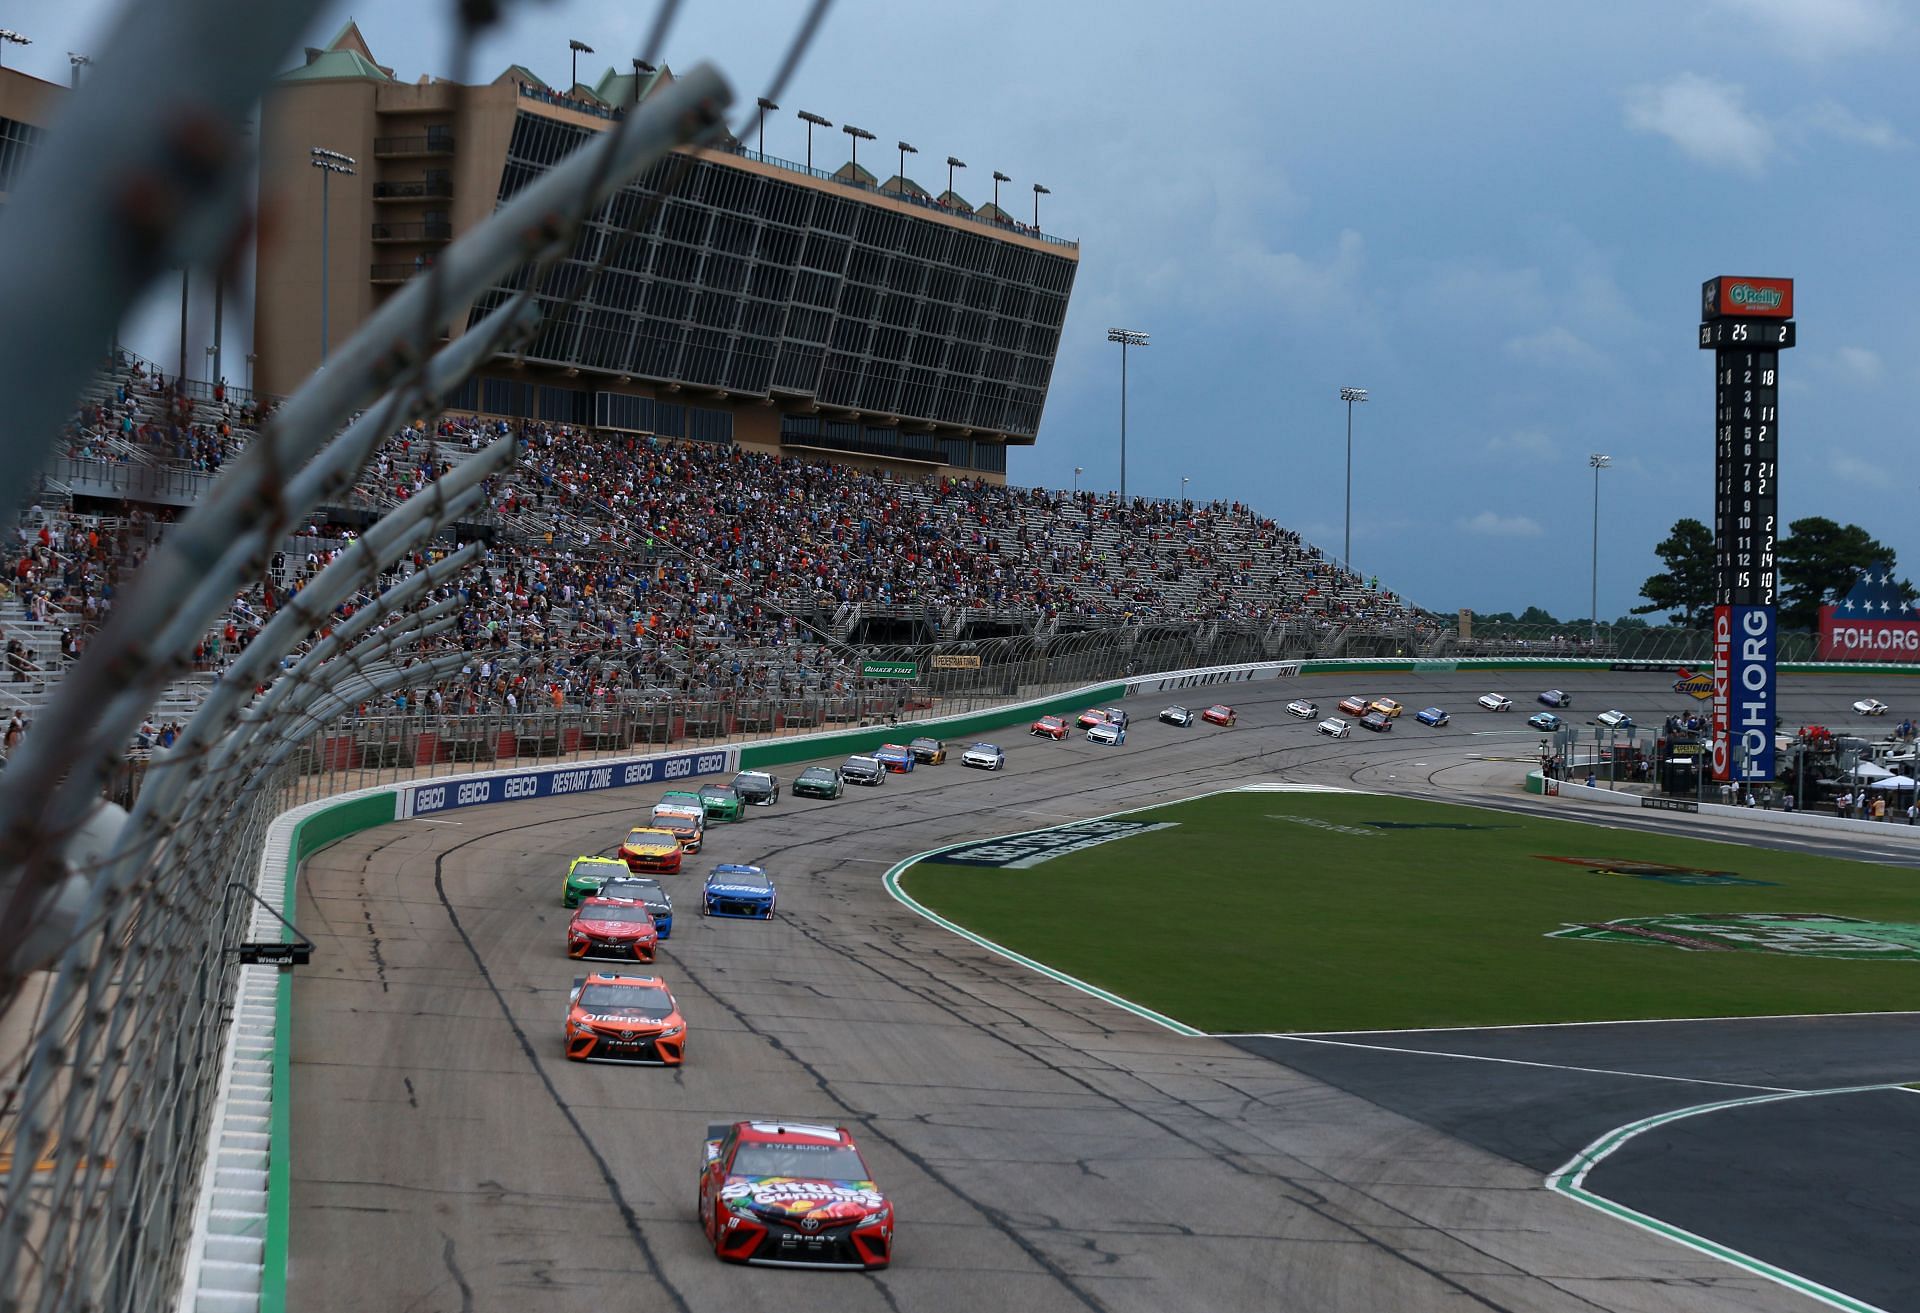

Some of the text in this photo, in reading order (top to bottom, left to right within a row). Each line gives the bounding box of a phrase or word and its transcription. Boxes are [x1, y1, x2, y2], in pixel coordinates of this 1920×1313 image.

[1730, 283, 1784, 308] O'Reilly
[1732, 324, 1787, 342] 25 2
[1746, 354, 1752, 366] 1
[1743, 370, 1774, 386] 2 18
[1744, 391, 1751, 403] 3
[1743, 406, 1774, 421] 4 11
[1744, 426, 1767, 442] 5 2
[1744, 444, 1751, 456] 6
[1743, 464, 1751, 476] 7
[1759, 462, 1774, 478] 21
[1744, 479, 1766, 495] 8 2
[1744, 500, 1751, 512] 9
[1738, 516, 1773, 532] 10 2
[1738, 536, 1773, 551] 11 2
[1738, 554, 1751, 566] 12
[1761, 553, 1773, 568] 14
[1738, 572, 1773, 588] 15 10
[1765, 589, 1773, 605] 2
[1833, 627, 1919, 650] FOH.ORG
[864, 665, 893, 674] QUAKER
[1178, 671, 1232, 689] ATLANTA
[1678, 682, 1714, 693] SUNO
[1713, 615, 1731, 775] QuikTrip
[1742, 610, 1768, 777] FOH.ORG
[417, 754, 723, 810] GEICO GEICO GEICO RESTART ZONE GEICO GEICO GEICO
[581, 1013, 662, 1026] Offerpad
[721, 1182, 883, 1202] Skittles
[754, 1192, 881, 1208] Gummies
[727, 1216, 740, 1229] 18
[782, 1233, 837, 1242] CAMRY
